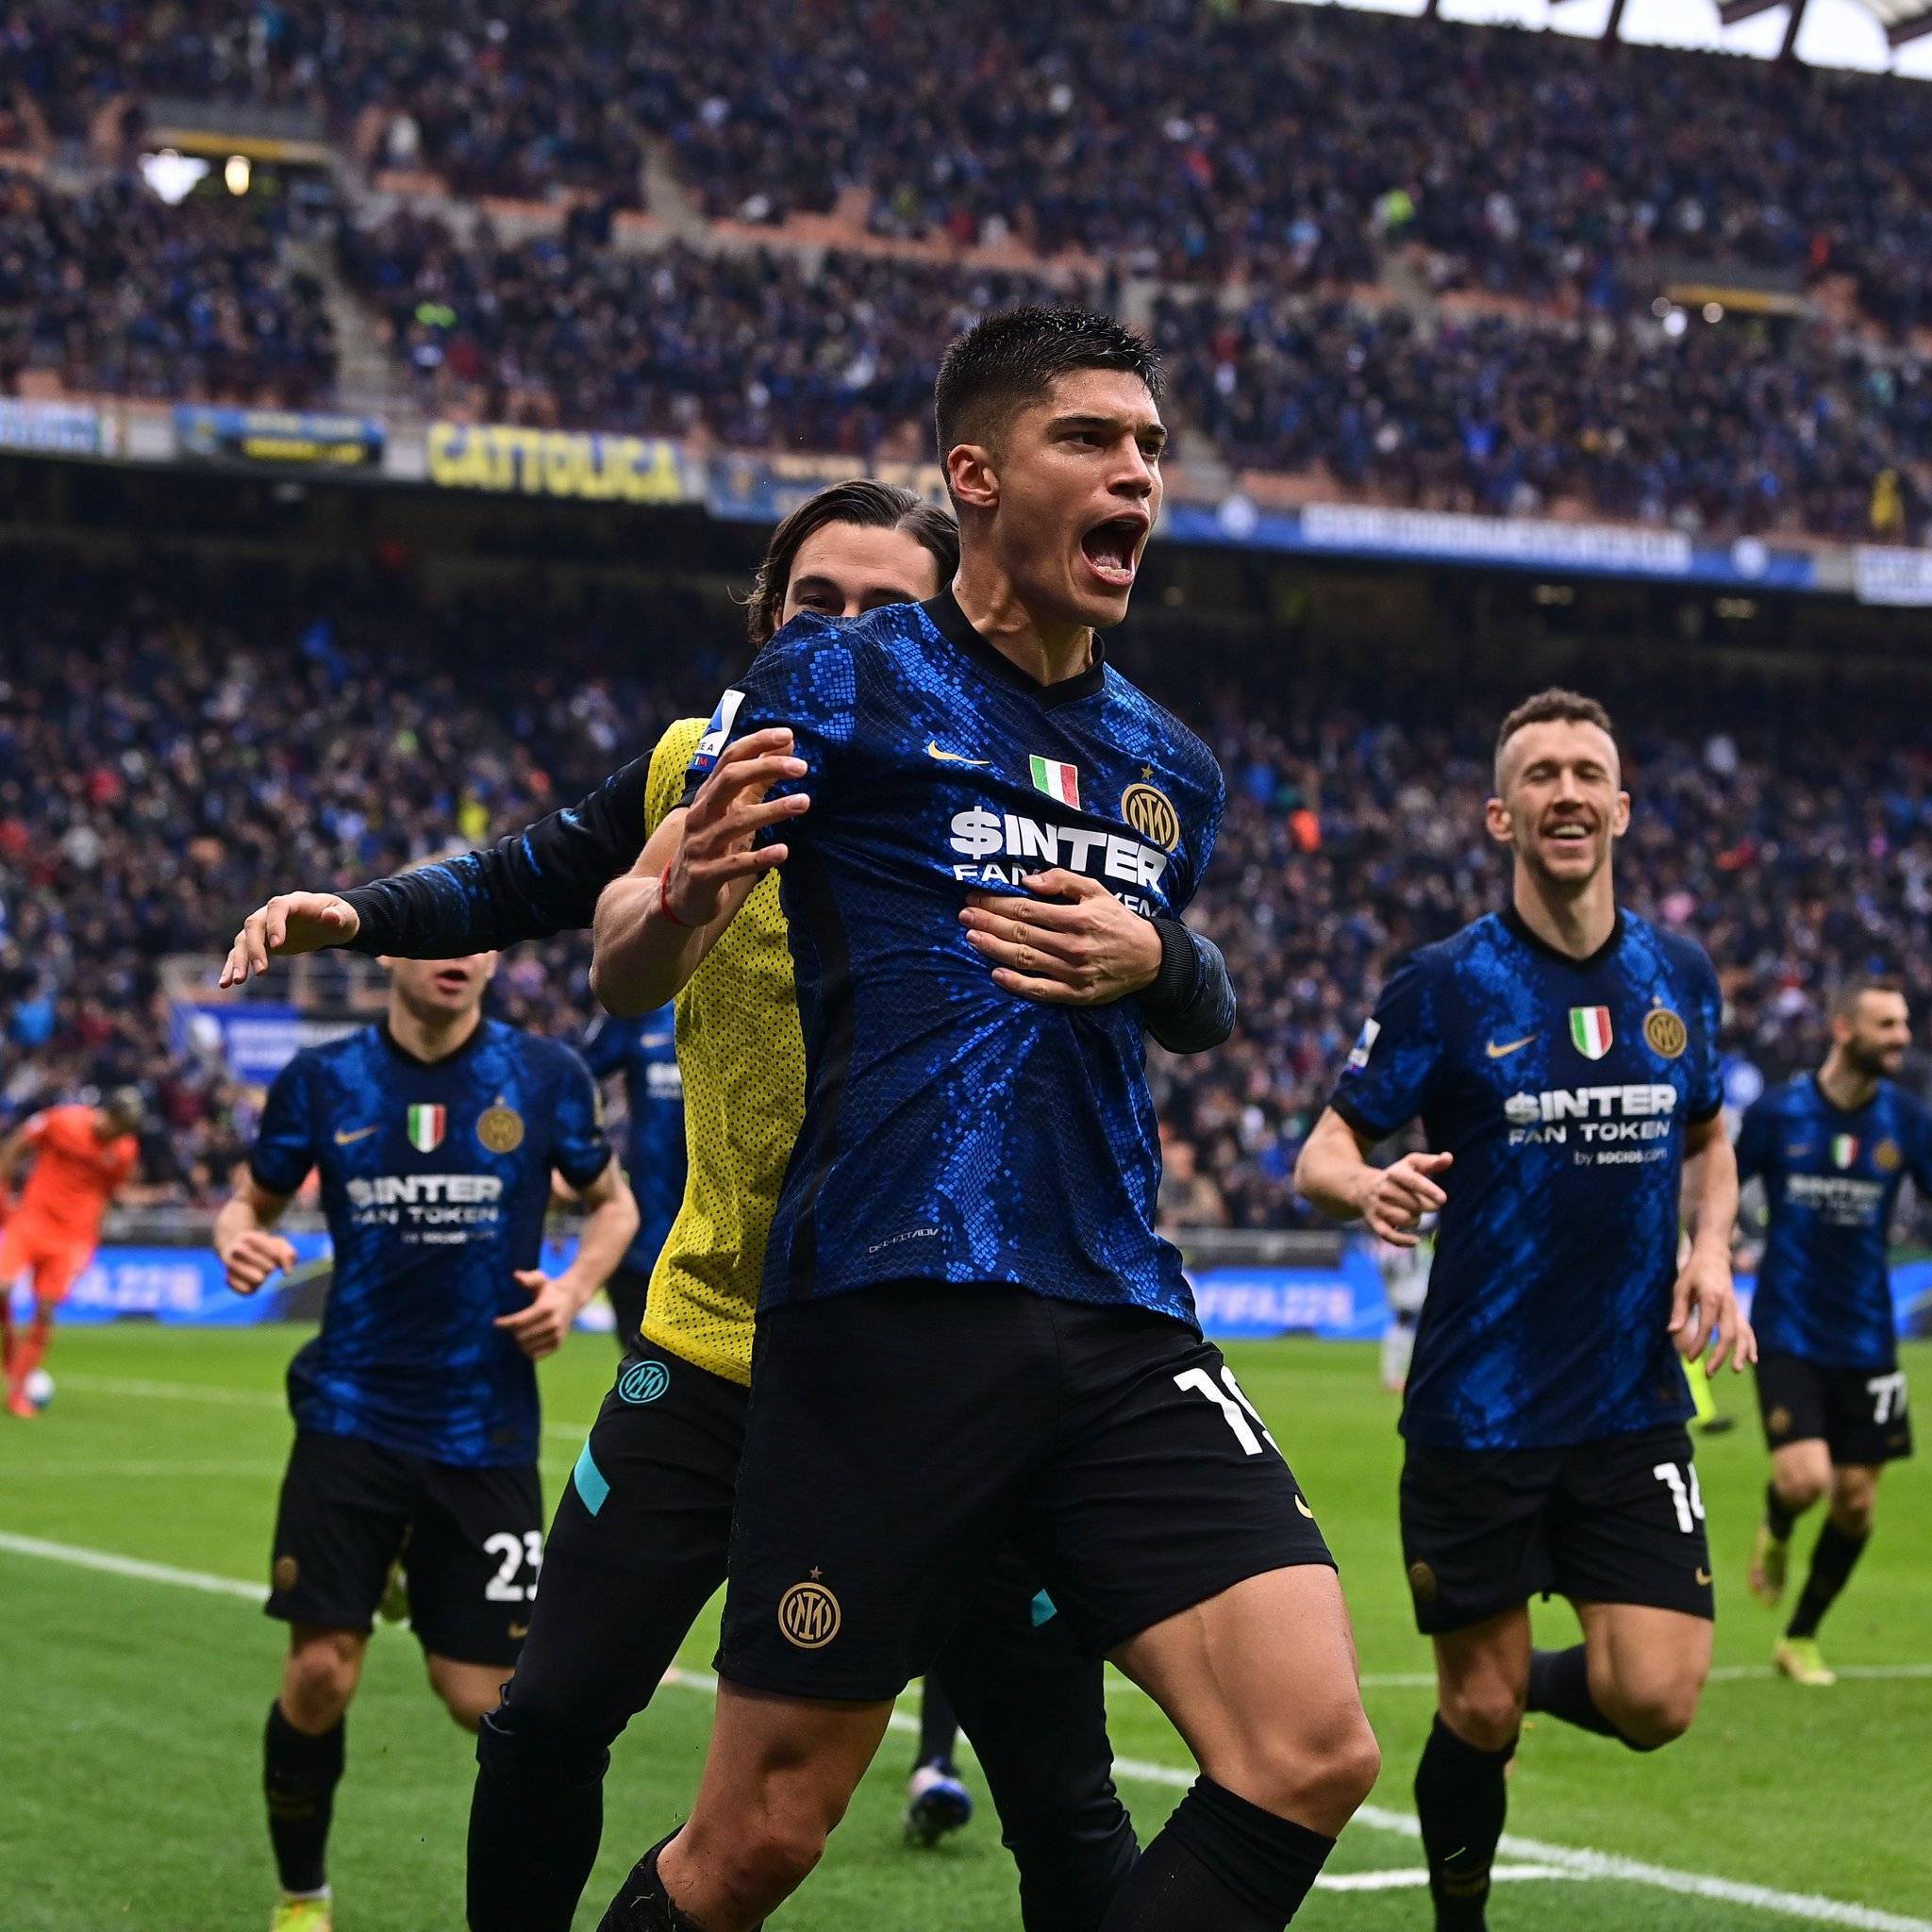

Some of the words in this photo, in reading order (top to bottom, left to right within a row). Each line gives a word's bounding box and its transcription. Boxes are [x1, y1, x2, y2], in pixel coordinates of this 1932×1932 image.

[949, 805, 1168, 894] $INTER
[1504, 1084, 1678, 1124] $INTER
[1508, 1126, 1568, 1147] FAN
[1579, 1120, 1672, 1142] TOKEN
